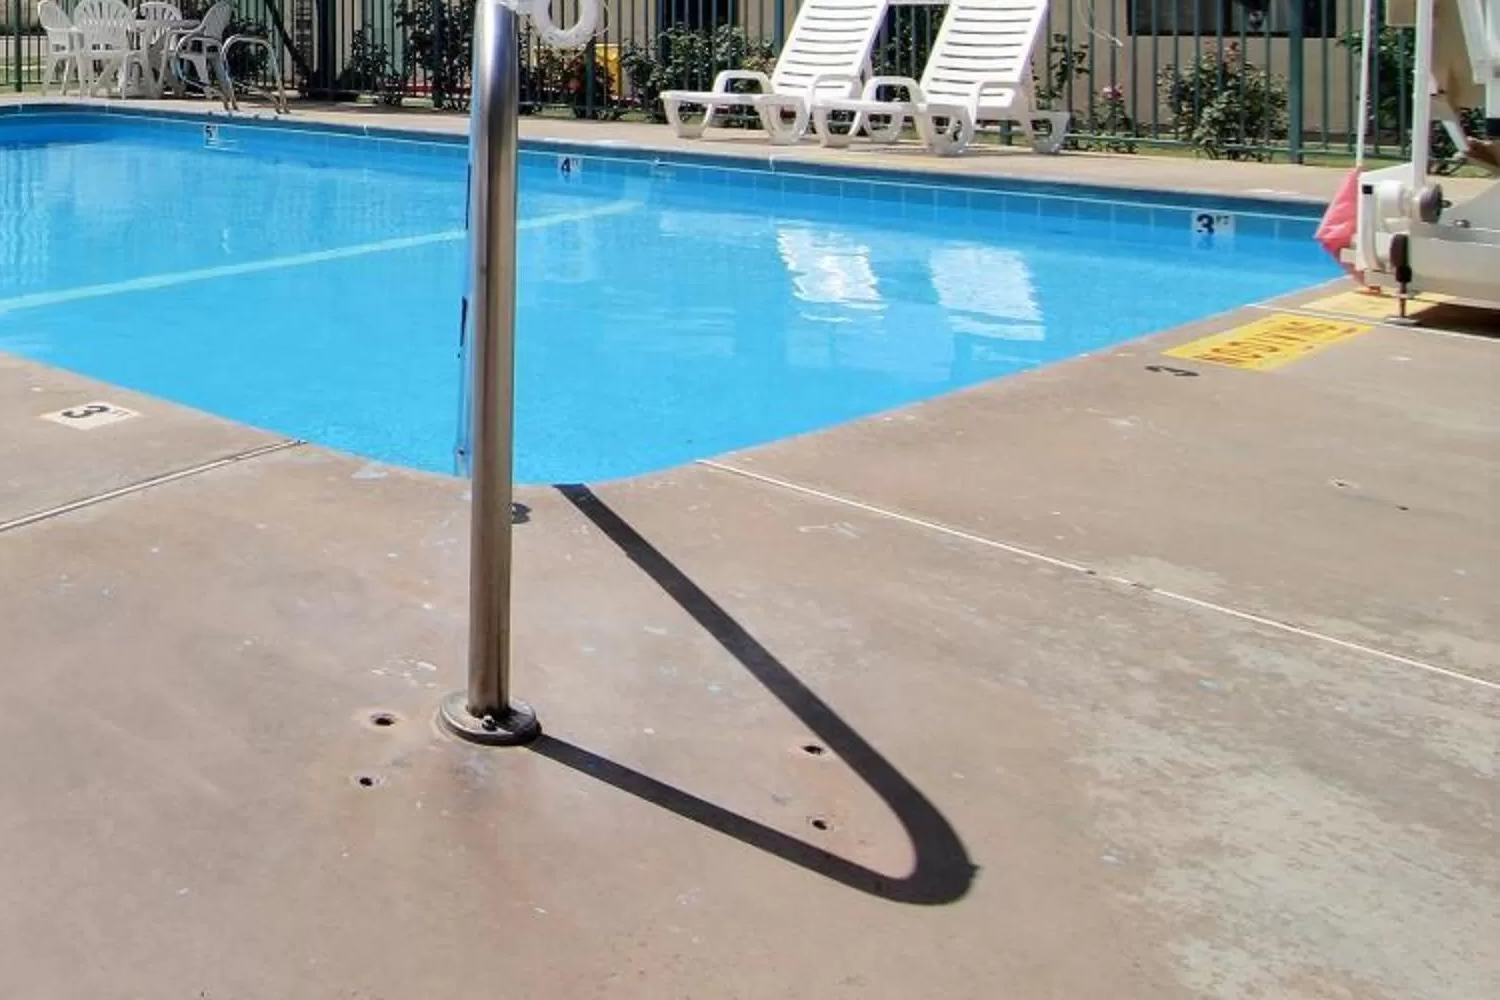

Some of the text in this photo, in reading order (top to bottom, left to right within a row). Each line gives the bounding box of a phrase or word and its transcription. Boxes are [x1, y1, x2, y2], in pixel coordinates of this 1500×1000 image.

[561, 157, 571, 173] 4
[1196, 213, 1215, 234] 3
[61, 405, 110, 419] 3
